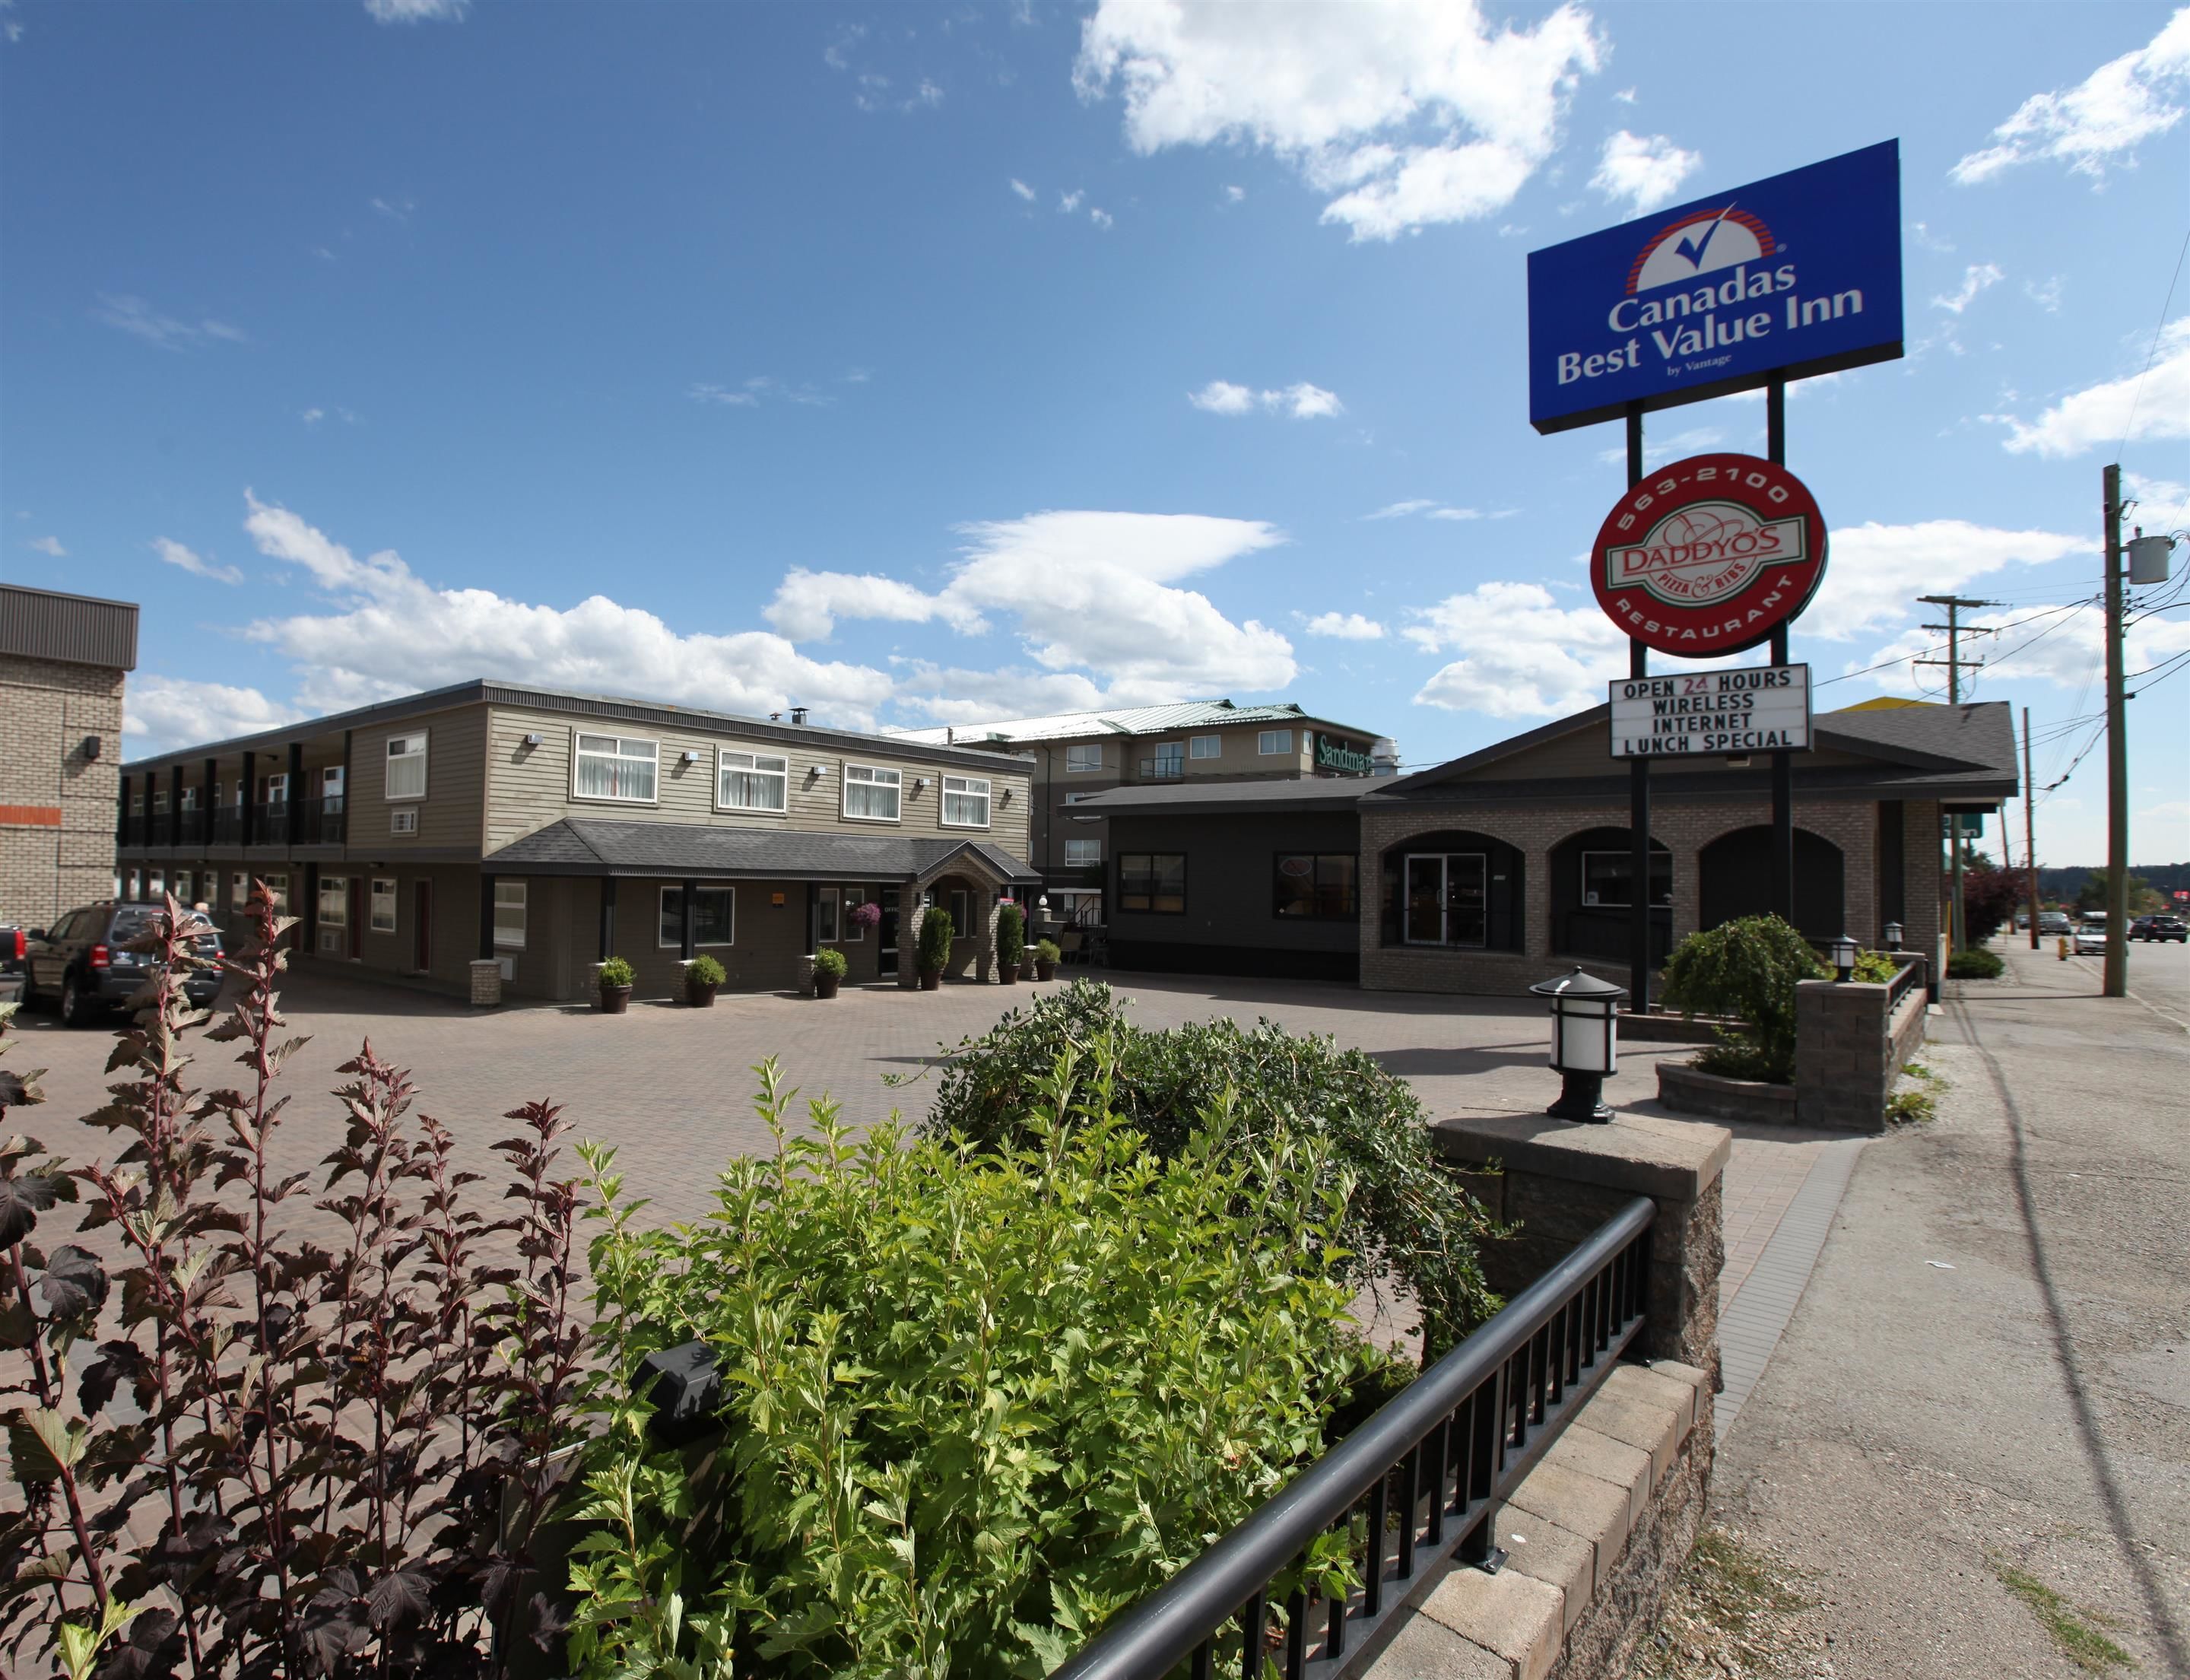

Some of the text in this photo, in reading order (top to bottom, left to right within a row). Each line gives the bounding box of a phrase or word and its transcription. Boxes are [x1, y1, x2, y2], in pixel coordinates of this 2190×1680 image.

[1608, 264, 1796, 333] Canadas
[1557, 287, 1863, 386] Best Value Inn
[1666, 353, 1733, 378] by Vantage
[1617, 466, 1789, 532] 563-2100
[1622, 526, 1781, 573] DADDYO'S
[1657, 573, 1689, 595] PIZZA
[1715, 562, 1747, 589] RIBS
[1615, 575, 1794, 640] RESTAURANT
[1624, 670, 1792, 700] OPEN 24 HOURS
[1652, 693, 1754, 716] WIRELESS
[1653, 712, 1753, 734] INTERNET
[1624, 730, 1793, 754] LUNCH SPECIAL
